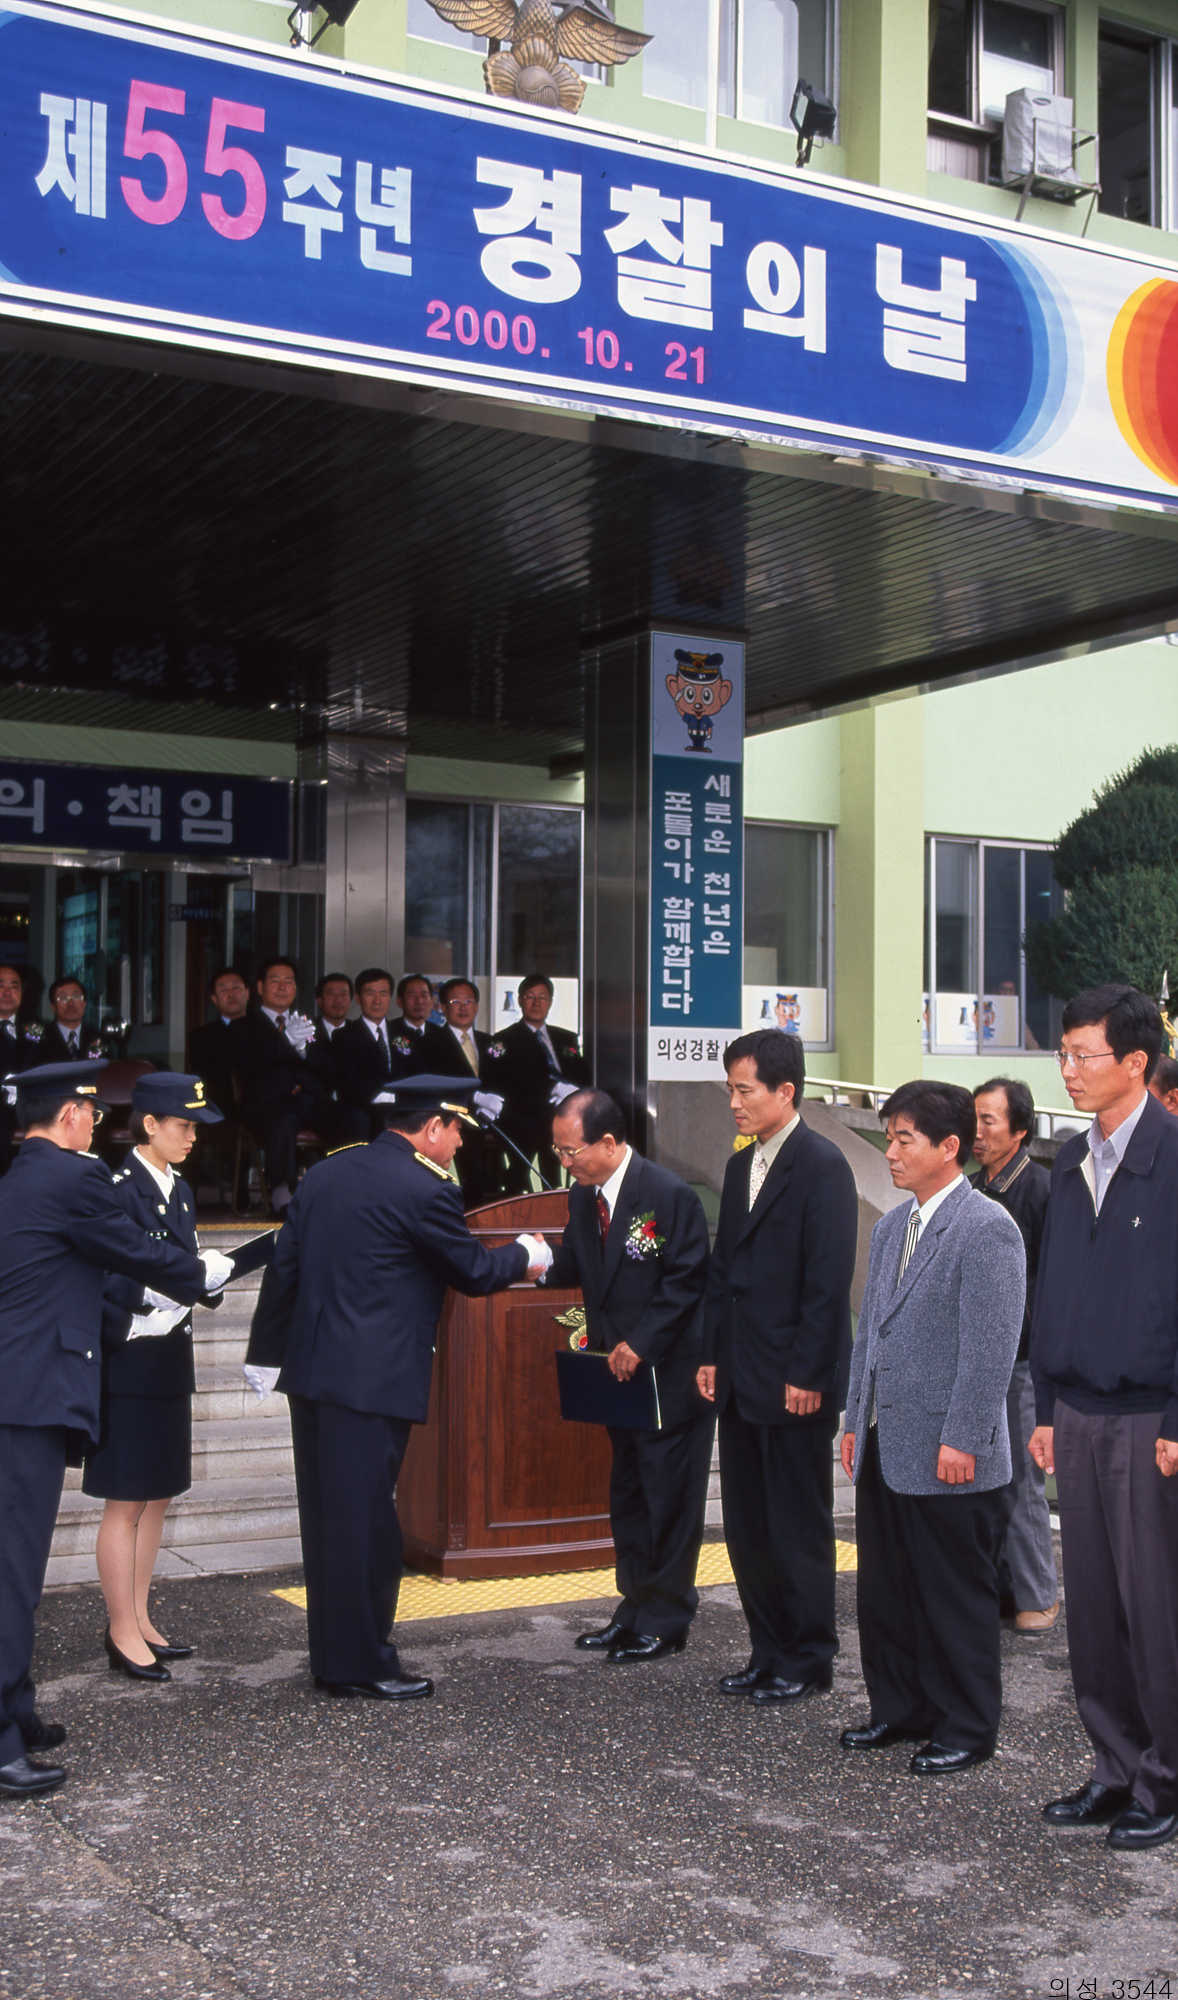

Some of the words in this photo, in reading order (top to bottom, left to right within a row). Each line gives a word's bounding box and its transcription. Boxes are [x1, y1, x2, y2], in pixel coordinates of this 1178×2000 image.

[35, 79, 412, 276] 제55주년
[473, 157, 826, 353] 경찰의
[876, 243, 977, 382] 날
[426, 300, 550, 357] 2000.
[578, 326, 633, 372] 10.
[665, 342, 705, 384] 21
[663, 791, 694, 884] 포돌이가
[704, 775, 732, 854] 새로운
[662, 897, 694, 1014] 함께합니다
[703, 872, 731, 955] 천년은
[657, 1038, 733, 1062] 의성경찰
